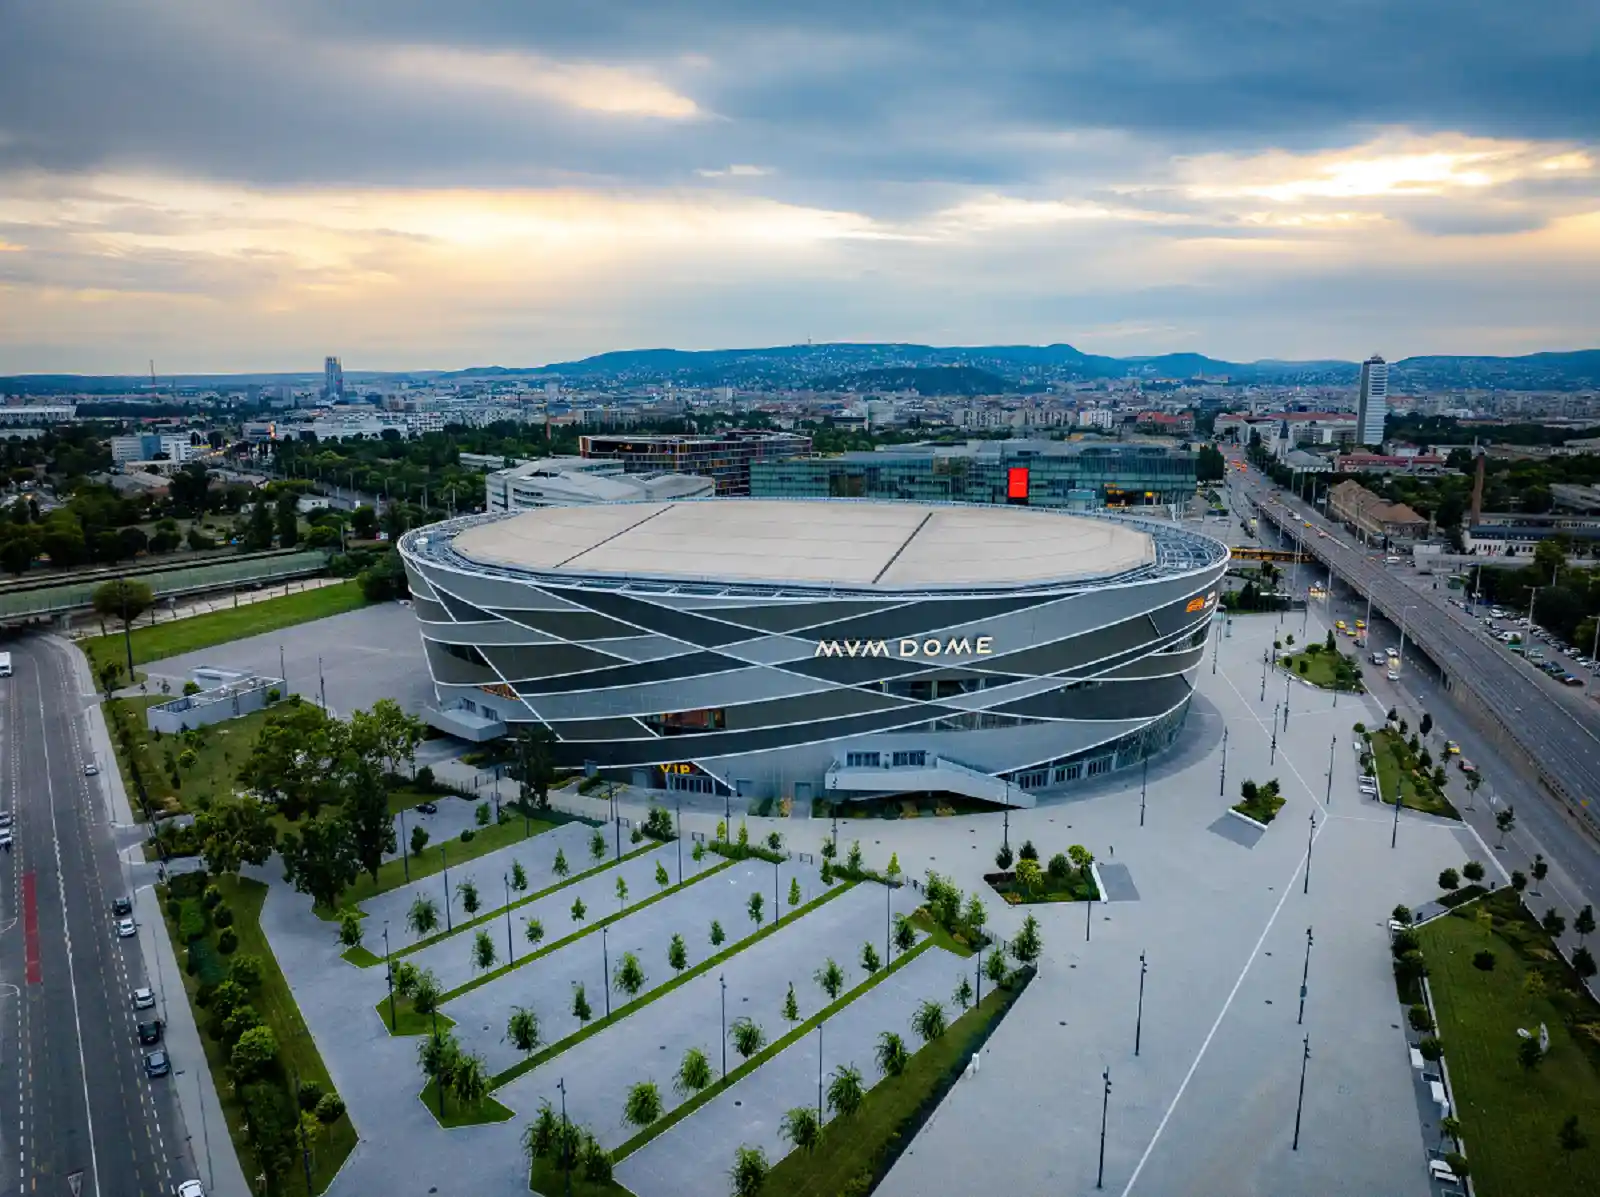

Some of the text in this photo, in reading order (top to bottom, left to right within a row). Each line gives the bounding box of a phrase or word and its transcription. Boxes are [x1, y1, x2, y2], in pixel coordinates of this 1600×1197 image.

[815, 636, 993, 657] MVM DOME
[660, 763, 690, 774] VIP
